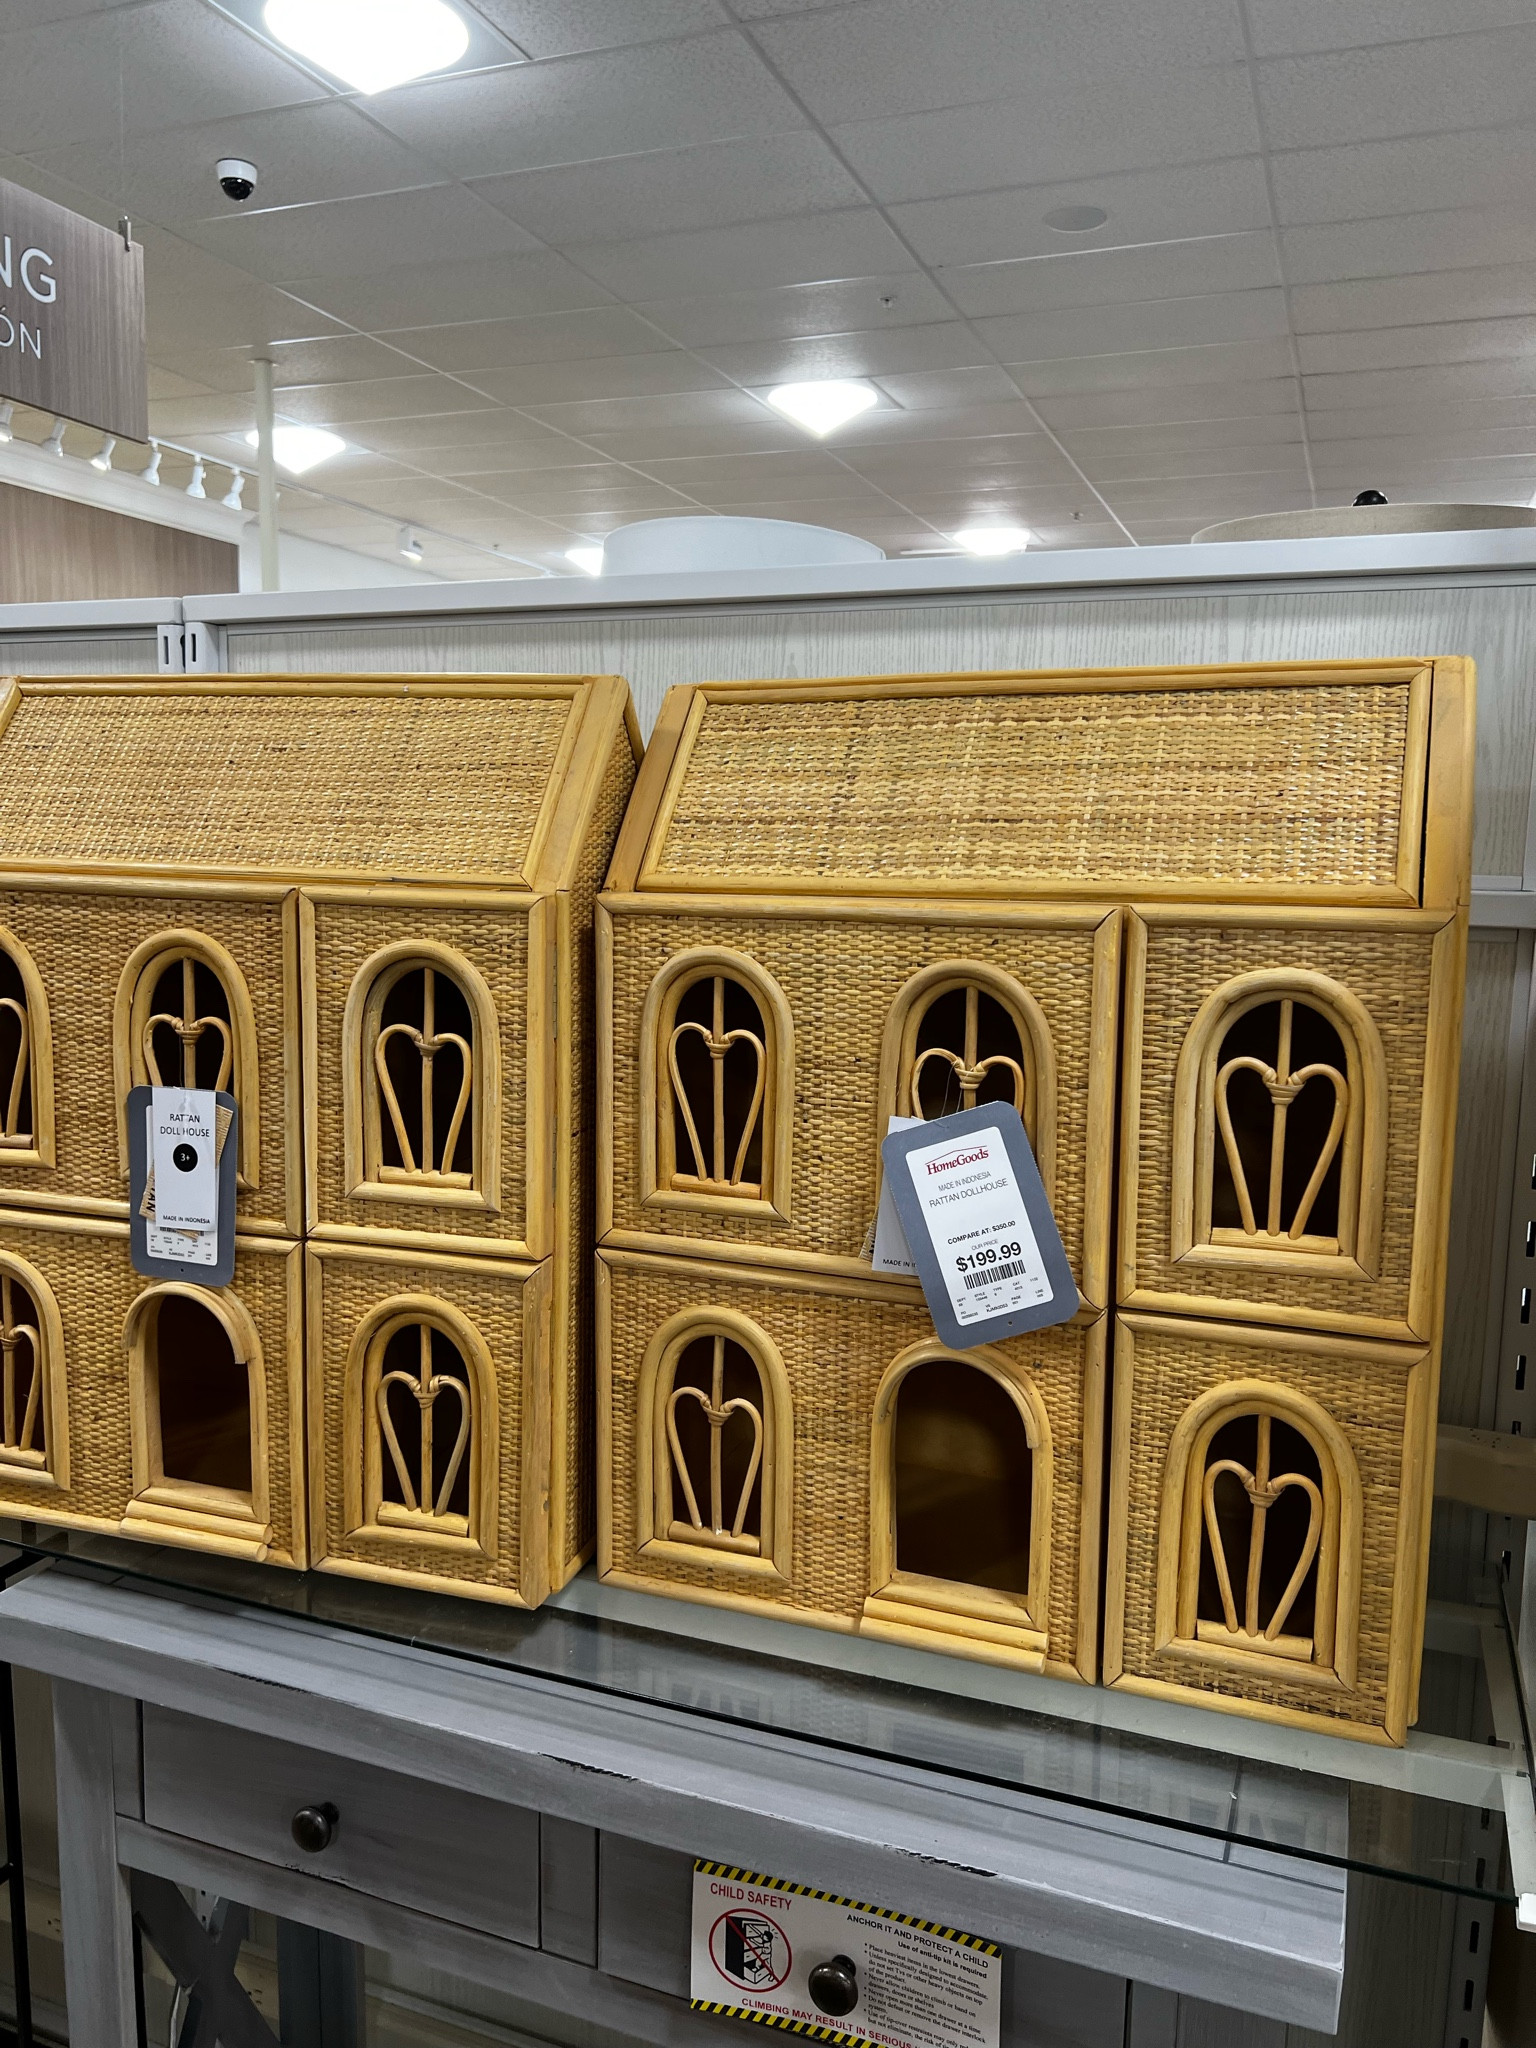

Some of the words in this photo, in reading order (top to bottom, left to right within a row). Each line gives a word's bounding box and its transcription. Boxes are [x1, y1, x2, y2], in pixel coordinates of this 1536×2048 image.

[160, 1126, 180, 1135] DOLL
[183, 1127, 210, 1137] HOUSE
[180, 1153, 190, 1161] 3+
[926, 1148, 989, 1175] HomeGoods
[929, 1193, 960, 1207] RATTAN
[960, 1178, 1008, 1198] DOLLHOUSE
[938, 1182, 955, 1191] MADE
[962, 1171, 991, 1185] INDONESIA
[948, 1230, 980, 1244] COMPARE
[992, 1220, 1016, 1232] $350.00
[983, 1239, 998, 1247] PRICE
[956, 1242, 1021, 1273] $199.99
[710, 1883, 744, 1900] CHILD
[748, 1891, 791, 1910] SAFETY
[846, 1914, 883, 1931] ANCHOR
[884, 1925, 892, 1933] IT
[894, 1929, 912, 1940] AND
[914, 1935, 953, 1954] PROTECT
[955, 1950, 961, 1958] A
[963, 1953, 988, 1968] CHILD
[869, 1944, 883, 1953] Place
[885, 1949, 905, 1961] heaviest
[939, 1968, 956, 1980] lowest
[957, 1976, 980, 1989] drawers.
[869, 1951, 887, 1962] Unless
[888, 1959, 917, 1974] specifically
[919, 1969, 942, 1982] designed
[898, 1941, 910, 1950] Use
[920, 1950, 942, 1961] anti-tip
[943, 1957, 952, 1965] kit
[960, 1963, 987, 1979] required
[868, 1973, 884, 1983] Never
[886, 1980, 900, 1988] allow
[902, 1986, 923, 1997] children
[931, 1996, 946, 2006] climb
[885, 1973, 906, 1983] product.
[913, 1975, 927, 1984] other
[928, 1979, 943, 1991] heavy
[945, 1987, 964, 1998] objects
[868, 1980, 890, 1993] drawers,
[892, 1989, 906, 1998] doors
[915, 1998, 934, 2008] shelves
[868, 1988, 884, 1998] Never
[885, 1995, 898, 2003] open
[900, 2000, 913, 2008] more
[914, 2005, 926, 2013] than
[938, 2013, 956, 2024] drawer
[742, 1998, 789, 2015] CLIMBING
[792, 2009, 813, 2021] MAY
[815, 2014, 853, 2031] RESULT
[856, 2026, 867, 2035] IN
[868, 2030, 912, 2048] SERIOUS
[887, 2002, 903, 2012] defeat
[911, 2011, 931, 2022] remove
[942, 2022, 961, 2033] drawer
[962, 2030, 985, 2043] interlock
